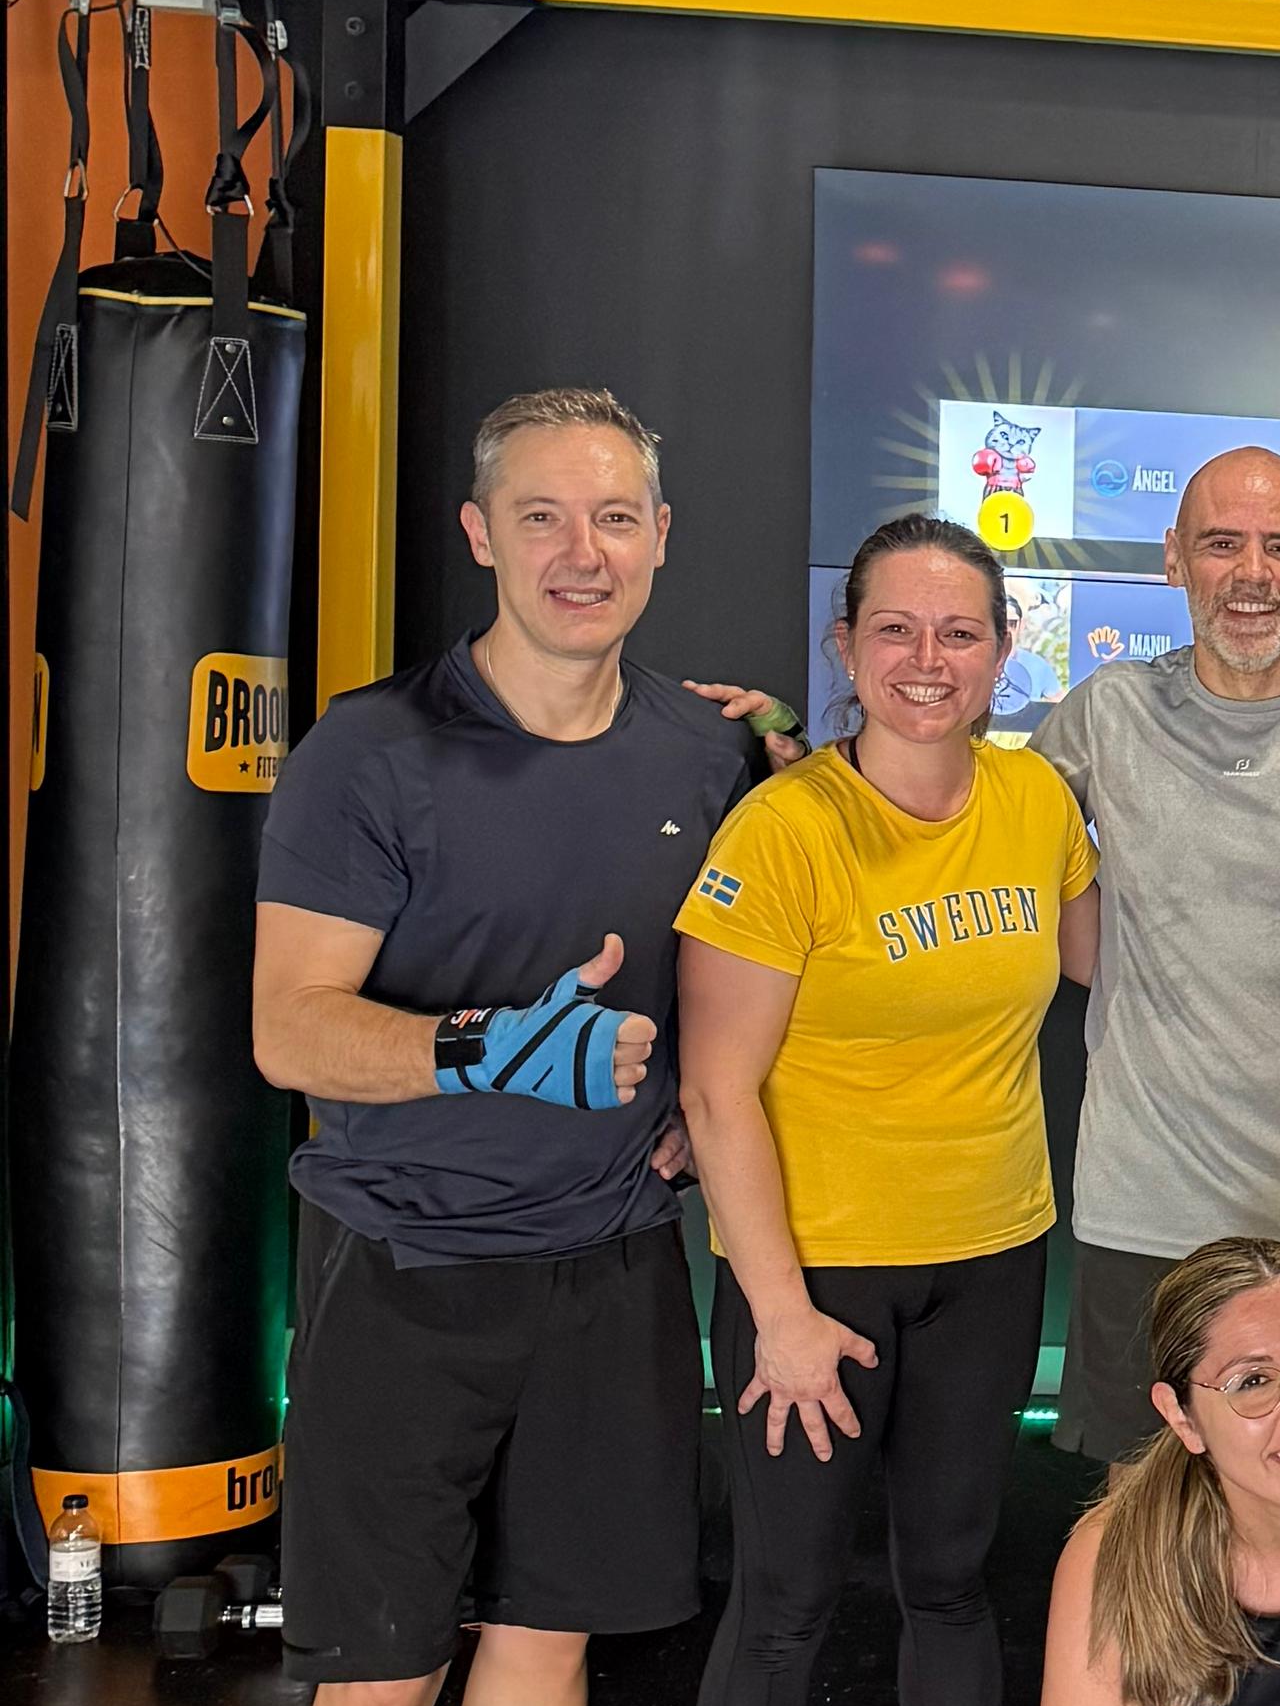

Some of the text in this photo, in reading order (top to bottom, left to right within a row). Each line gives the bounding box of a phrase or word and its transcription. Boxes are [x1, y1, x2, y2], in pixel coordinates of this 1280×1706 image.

[1132, 463, 1178, 493] ÁNGEL
[999, 513, 1009, 534] 1
[878, 886, 1041, 963] SWEDEN
[227, 1464, 280, 1512] bro
